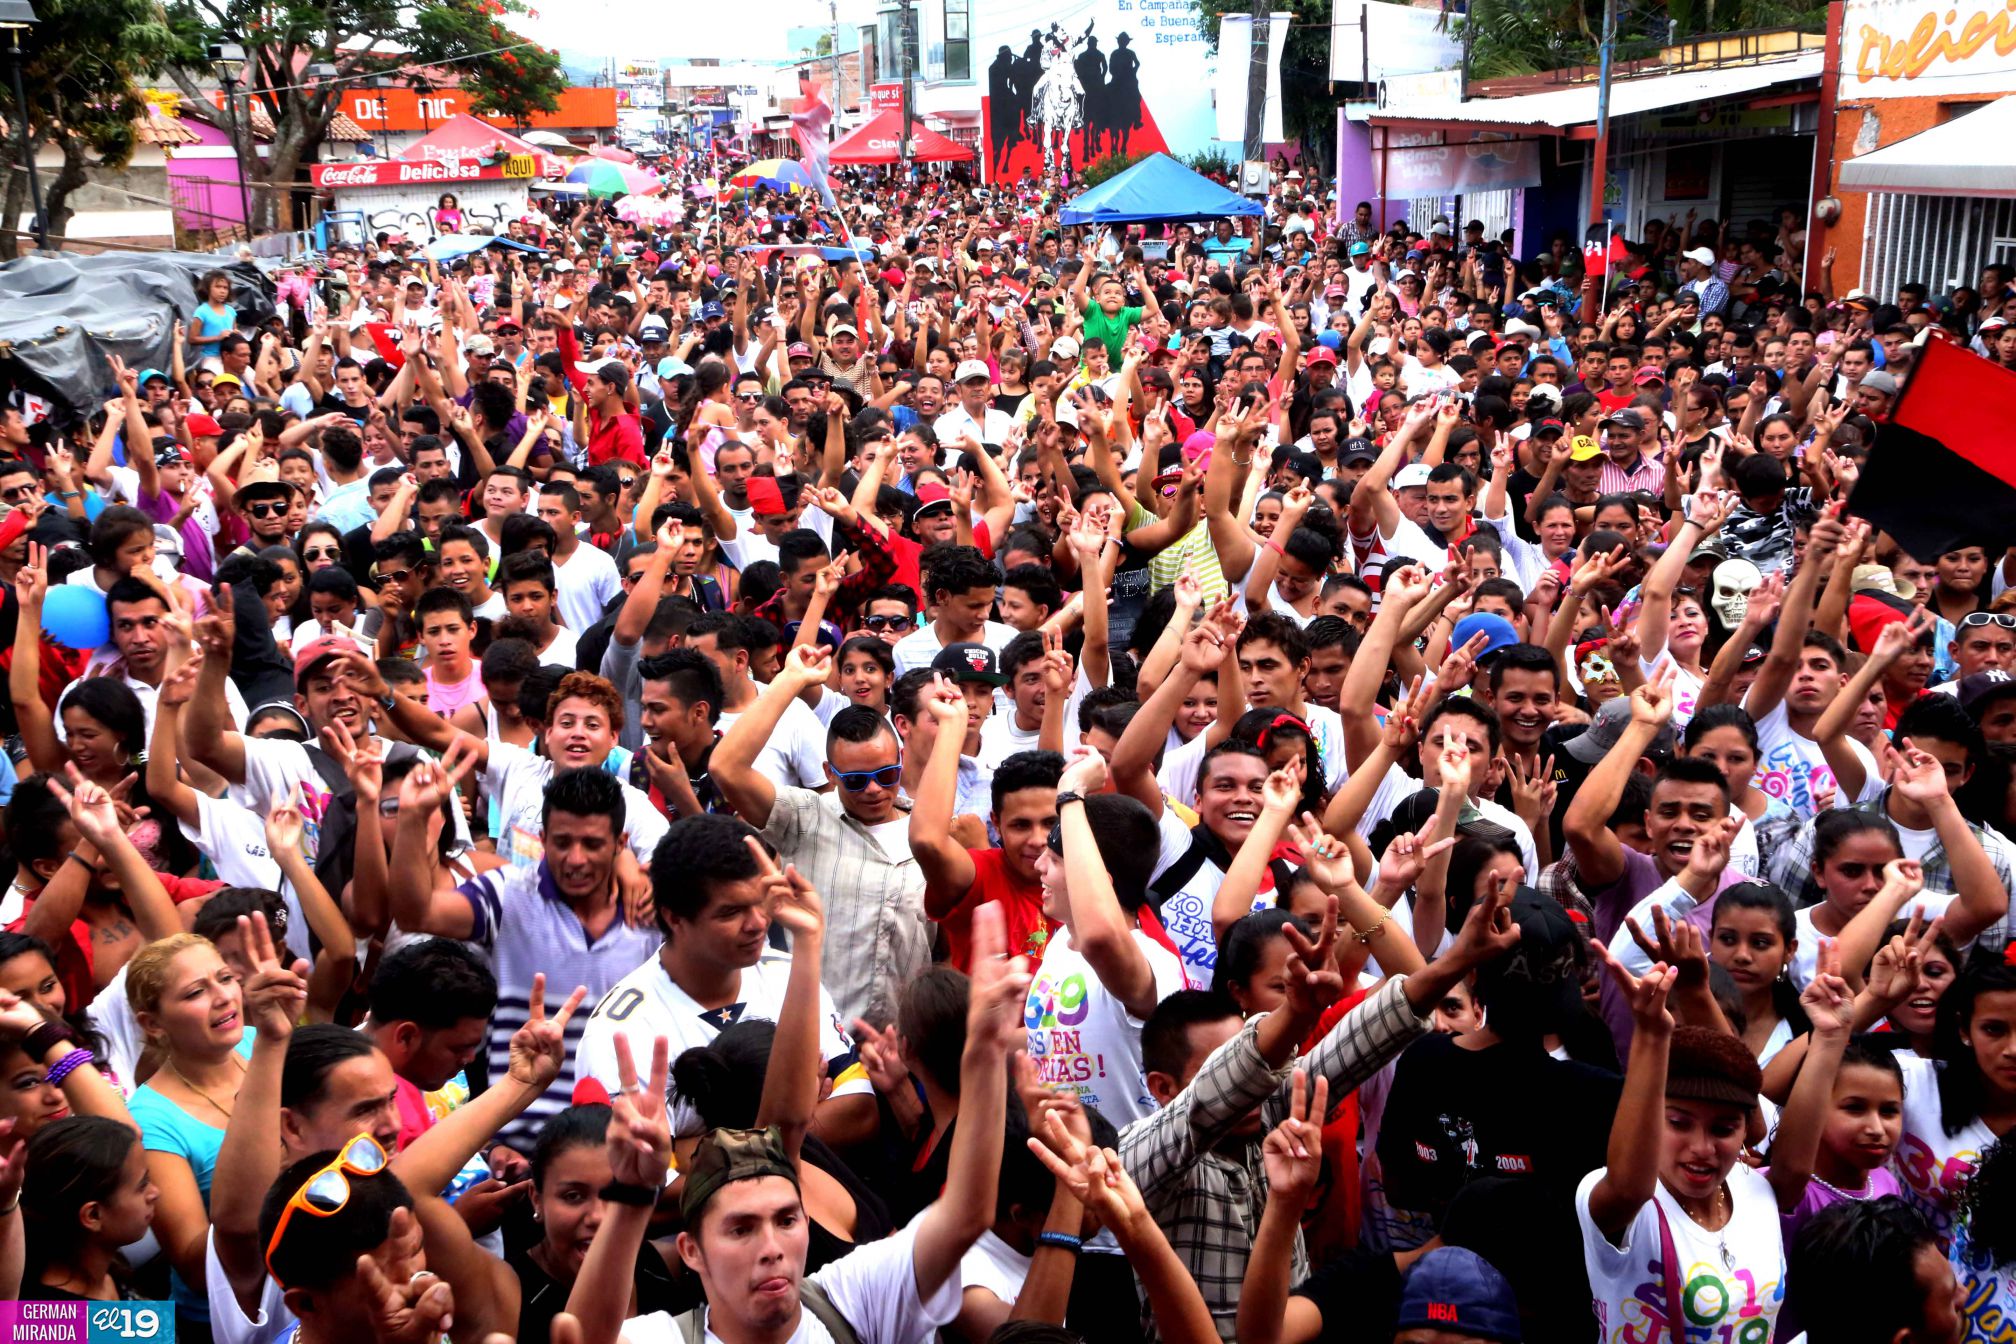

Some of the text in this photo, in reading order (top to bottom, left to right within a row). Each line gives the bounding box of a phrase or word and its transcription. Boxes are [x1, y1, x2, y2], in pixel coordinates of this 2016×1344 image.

[1141, 16, 1156, 27] de
[355, 98, 388, 120] DE
[400, 163, 480, 181] Deliciosa
[1050, 1030, 1082, 1055] EN
[1427, 1302, 1459, 1323] NBA
